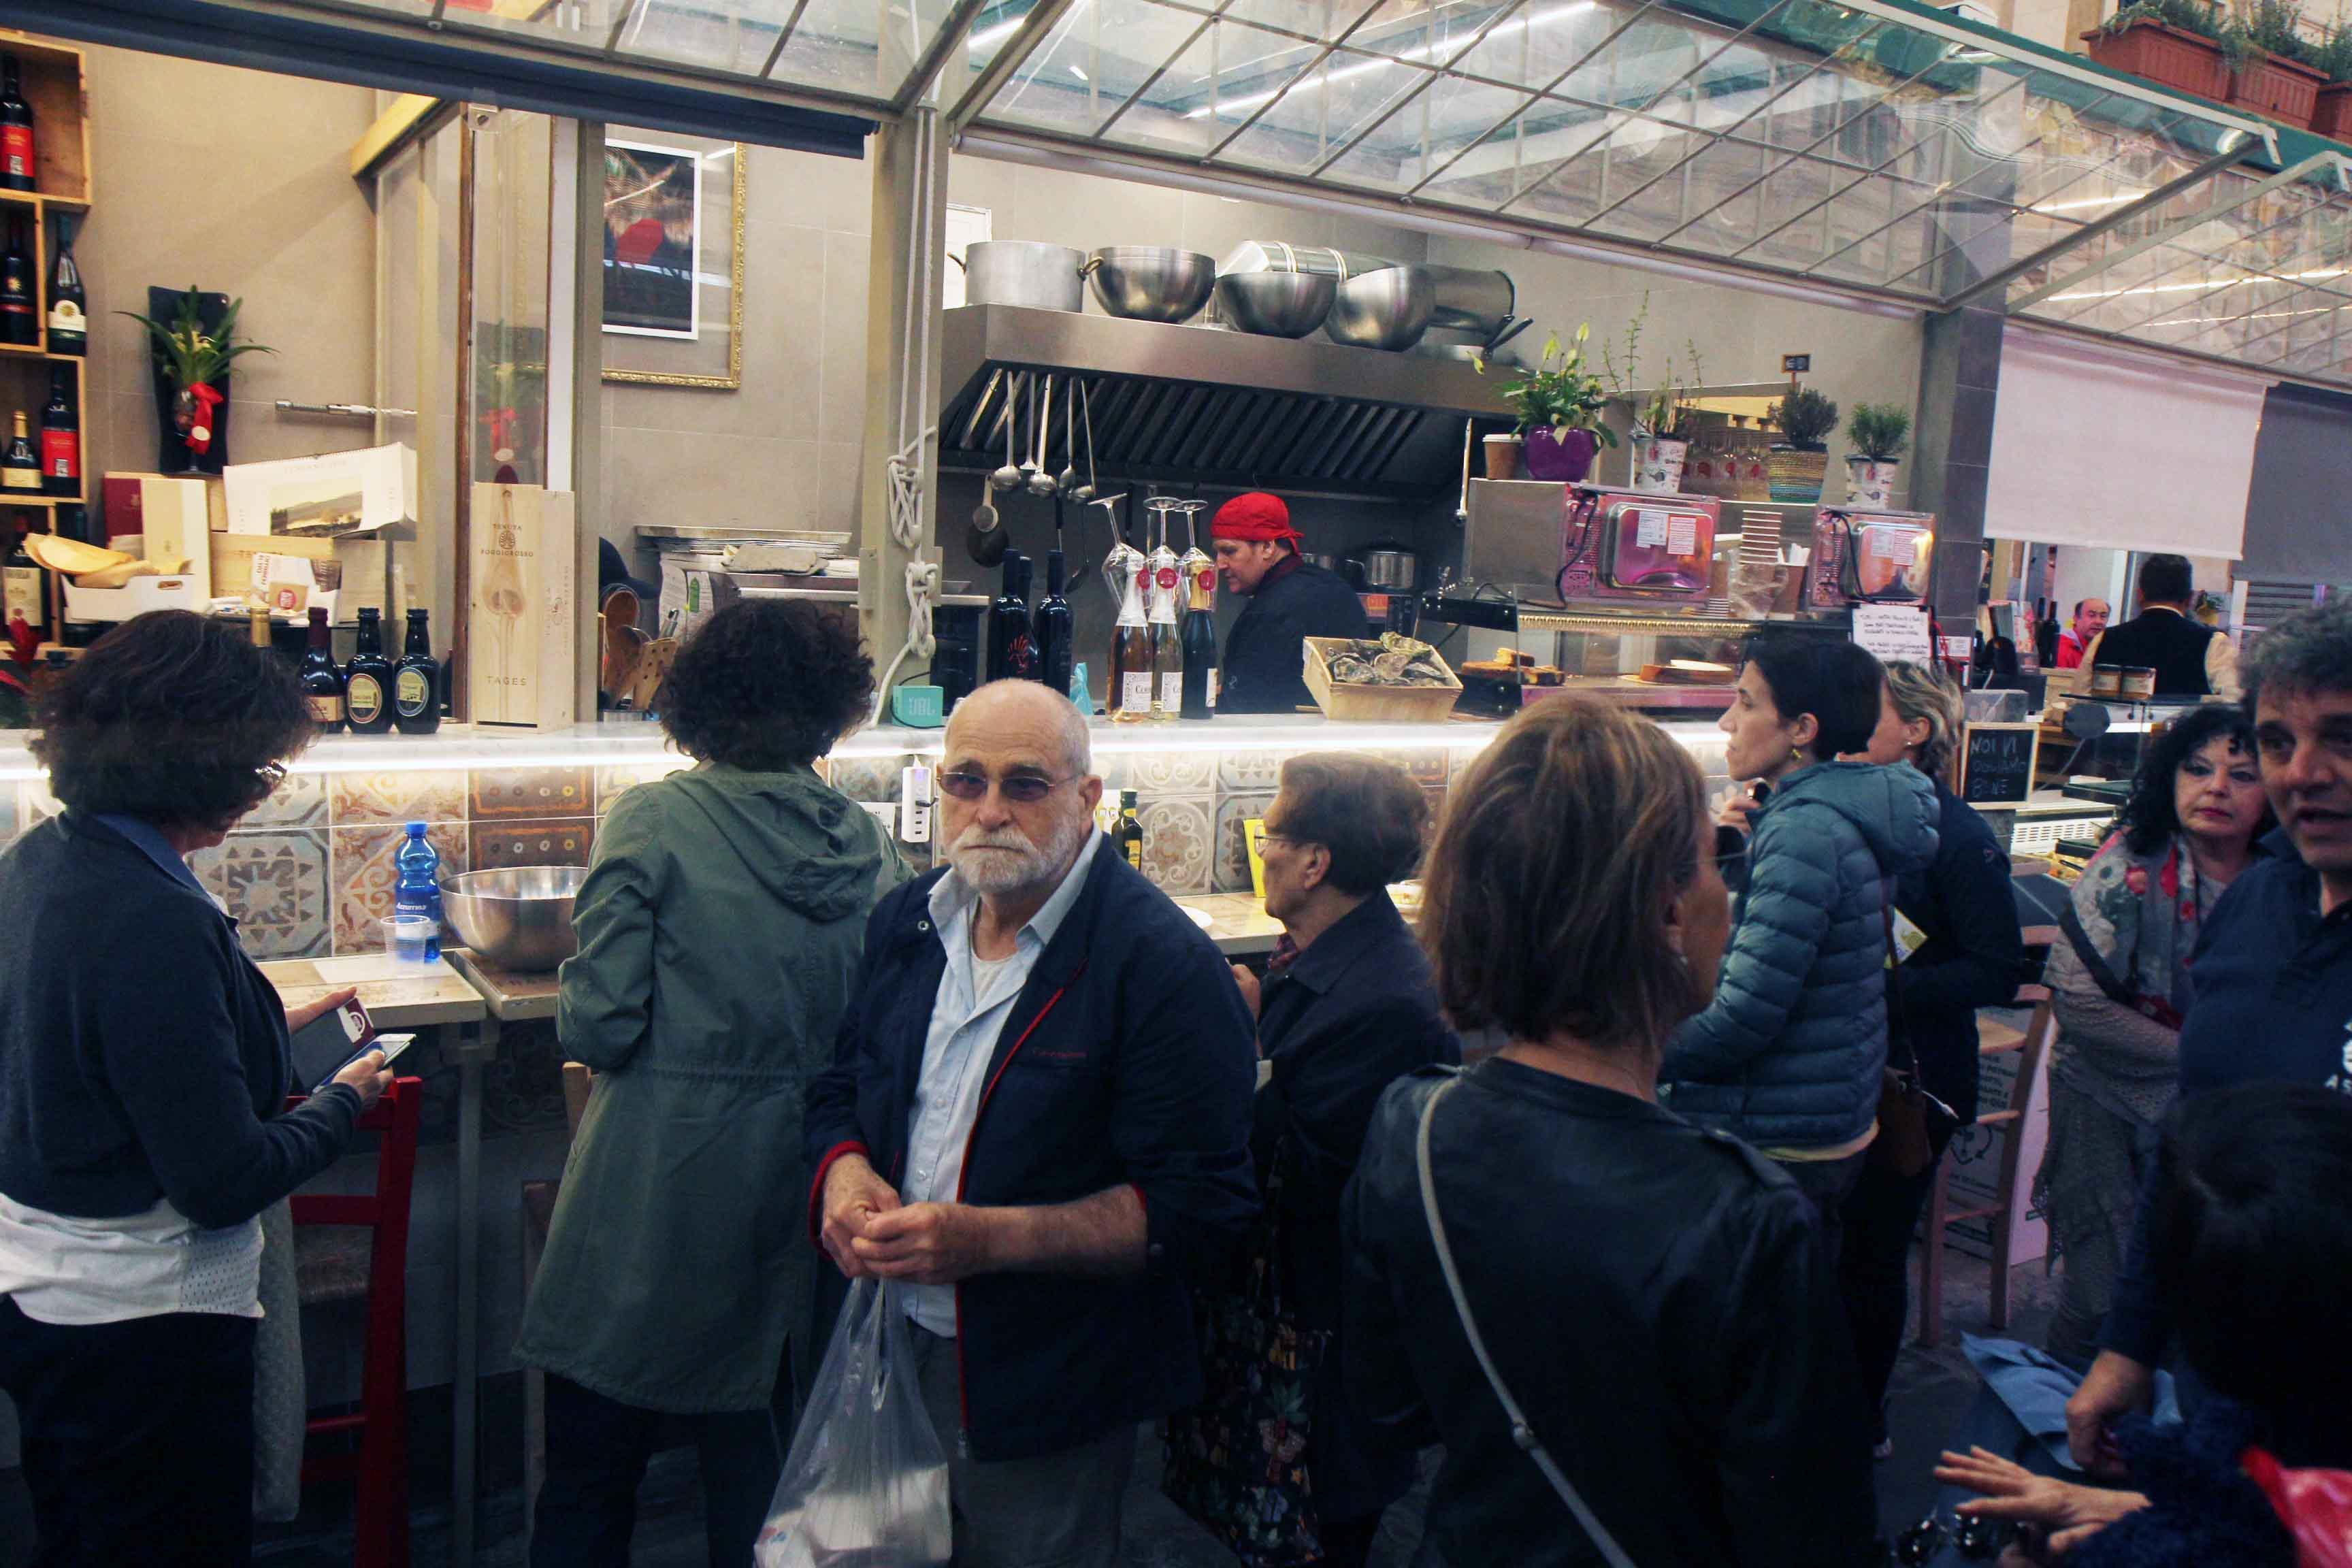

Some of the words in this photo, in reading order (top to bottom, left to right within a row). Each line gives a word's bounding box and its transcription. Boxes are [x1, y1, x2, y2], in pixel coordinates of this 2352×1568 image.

[492, 523, 523, 532] TENUTA
[487, 676, 528, 686] TAGES
[909, 696, 936, 715] JBL
[1970, 736, 1997, 755] NOI
[1971, 777, 2010, 799] BNE
